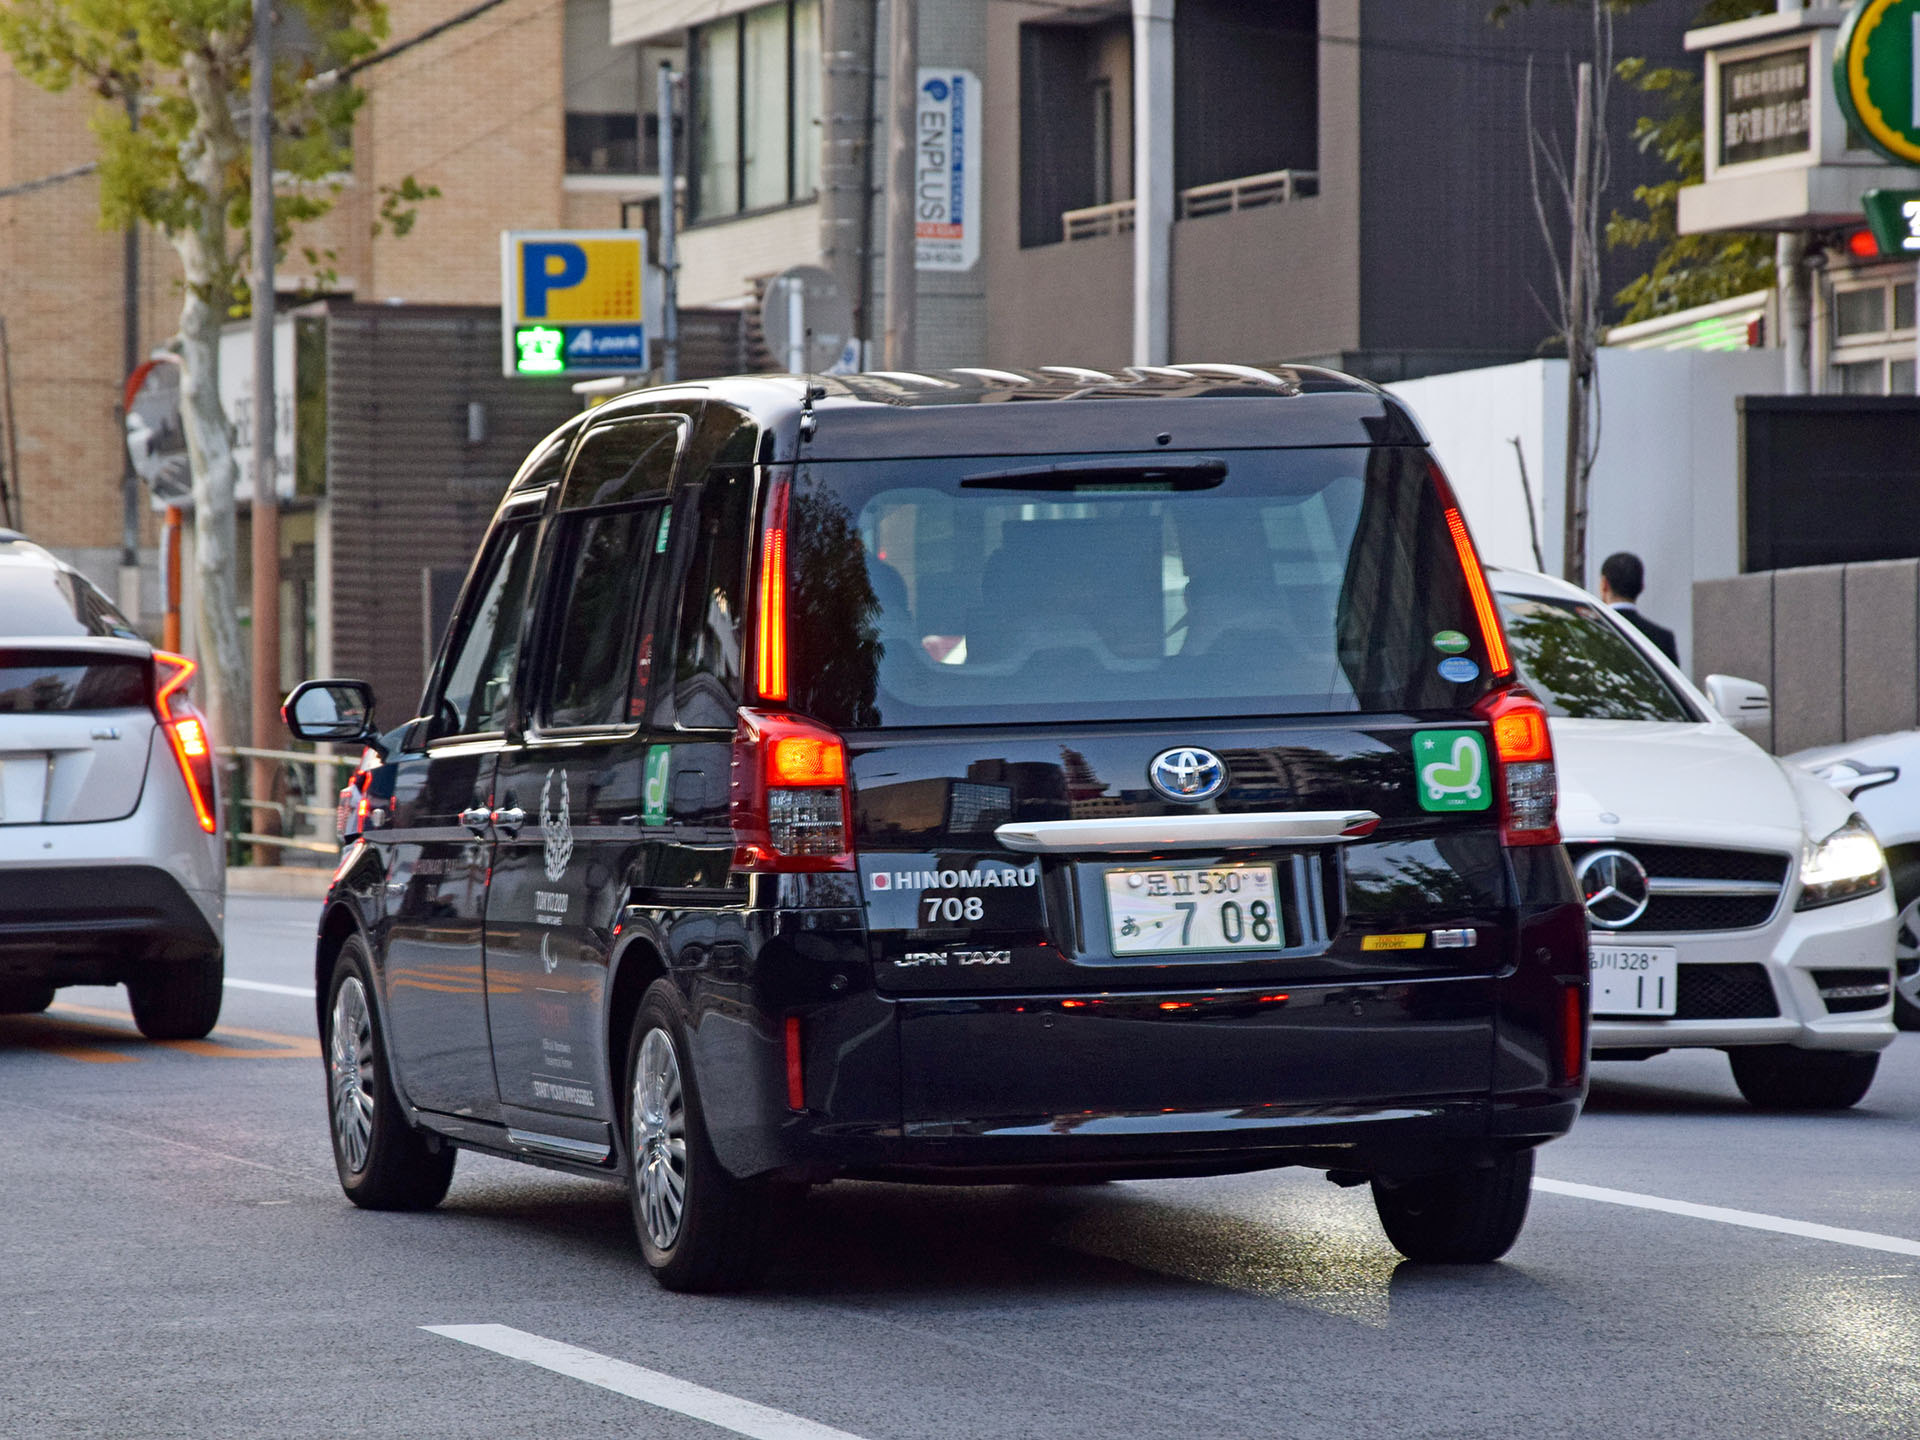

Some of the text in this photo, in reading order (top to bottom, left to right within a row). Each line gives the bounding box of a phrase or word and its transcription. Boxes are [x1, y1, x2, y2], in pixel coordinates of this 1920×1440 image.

[920, 111, 946, 220] ENPLUS
[523, 242, 588, 318] P
[894, 868, 1036, 889] HINOMARU
[923, 897, 984, 922] 708
[1121, 915, 1140, 937] あ
[894, 950, 1011, 967] JPN TAXI
